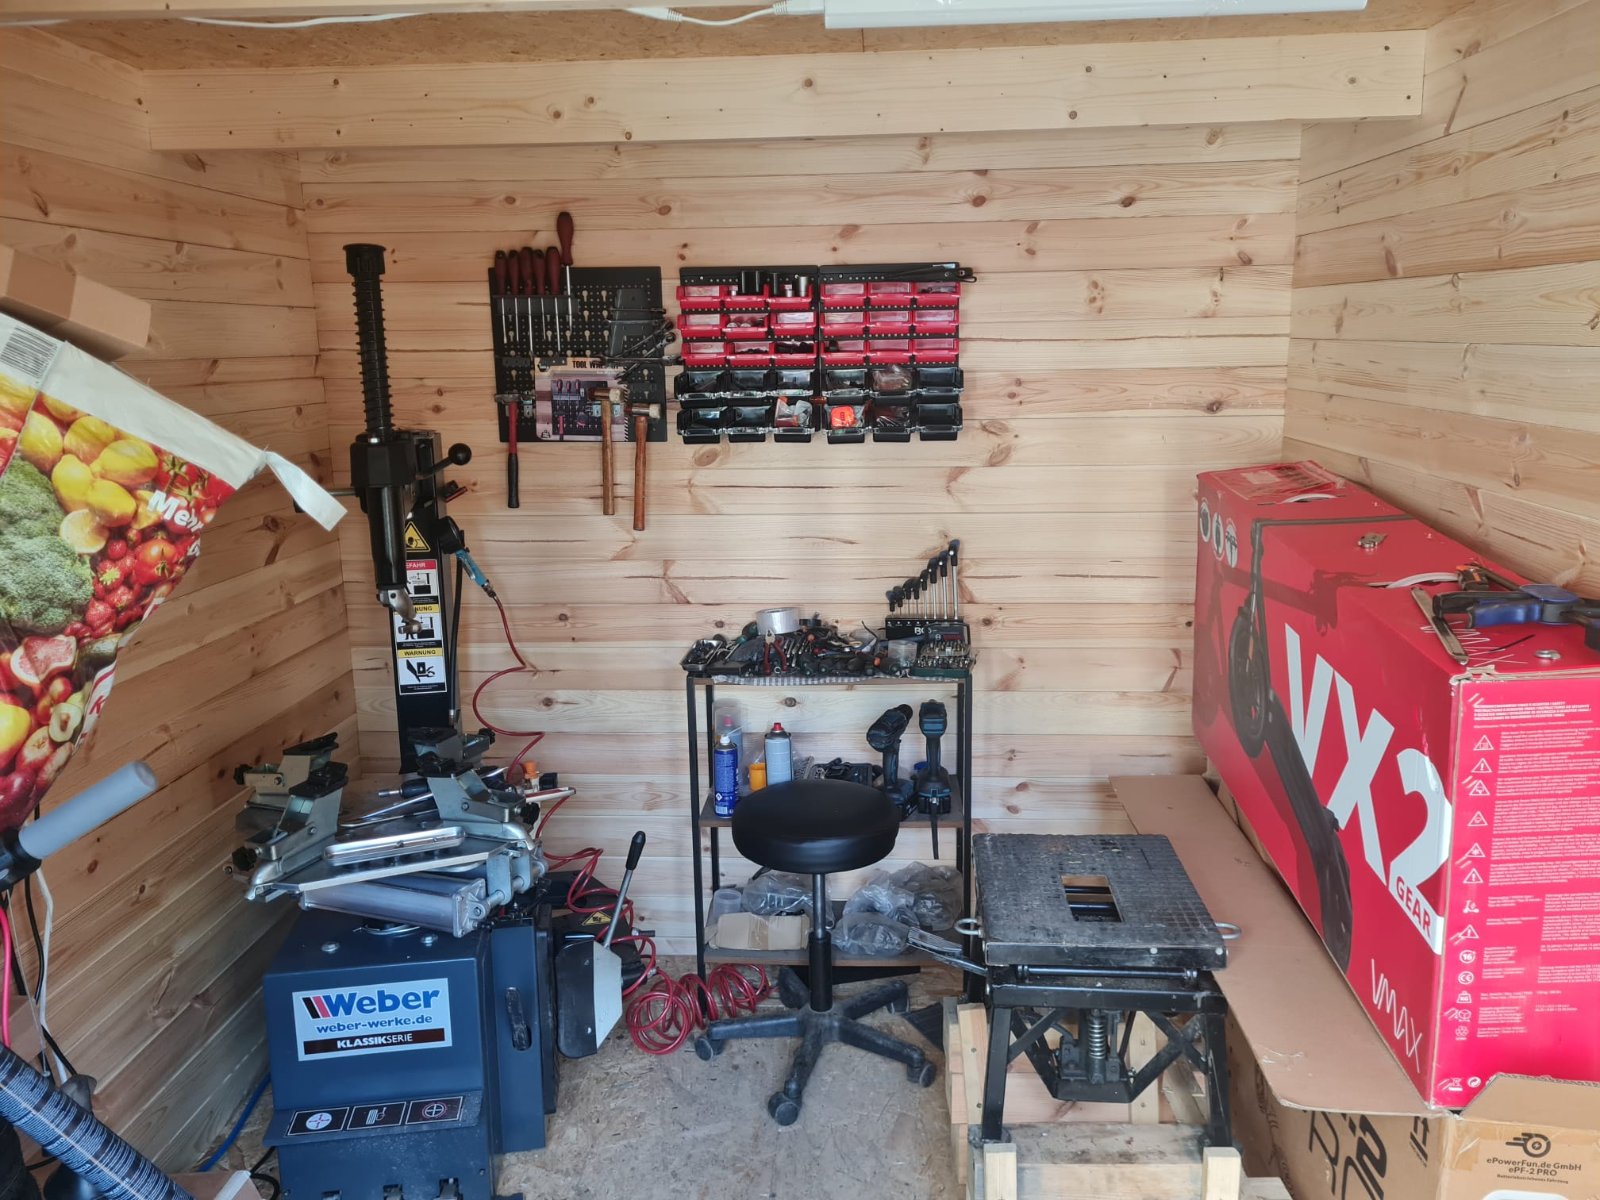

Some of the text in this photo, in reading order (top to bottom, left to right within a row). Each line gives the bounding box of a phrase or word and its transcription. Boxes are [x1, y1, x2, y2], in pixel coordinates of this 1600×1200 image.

[415, 605, 433, 613] NUNG
[404, 649, 436, 657] WARNUNG
[1285, 622, 1454, 955] VX2
[1396, 875, 1432, 939] GEAR
[322, 989, 440, 1018] Weber
[316, 1014, 433, 1034] weber-werke.de
[1371, 958, 1423, 1074] VMAX
[336, 1033, 413, 1049] KLASSIKSERIE
[1486, 1157, 1582, 1171] ePowerFun.de GmbH
[1508, 1166, 1558, 1177] ePF-2 PRO
